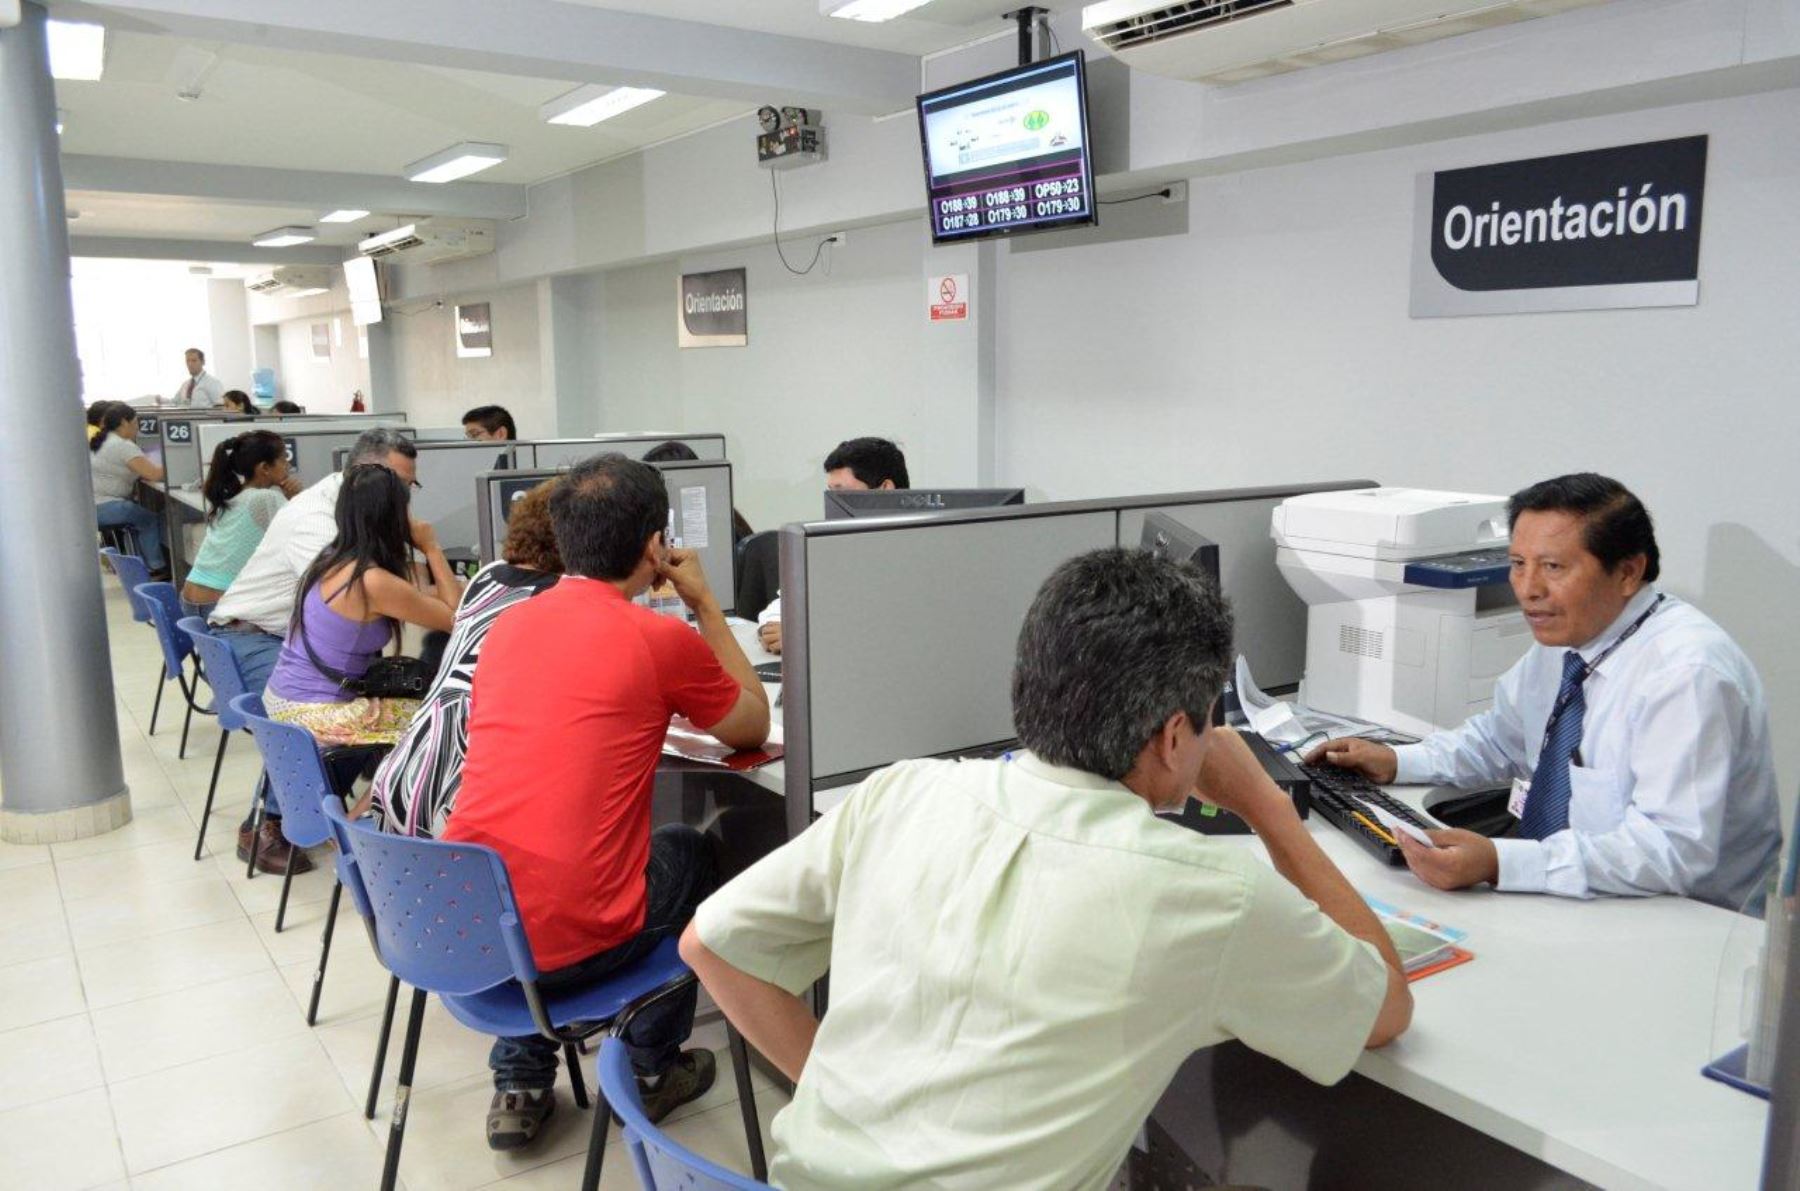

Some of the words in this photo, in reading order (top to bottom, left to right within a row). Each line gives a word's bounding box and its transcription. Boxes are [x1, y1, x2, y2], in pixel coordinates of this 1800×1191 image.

[1443, 183, 1686, 250] Orientación
[685, 288, 743, 314] Orientación
[140, 419, 157, 431] 27
[169, 425, 189, 439] 26
